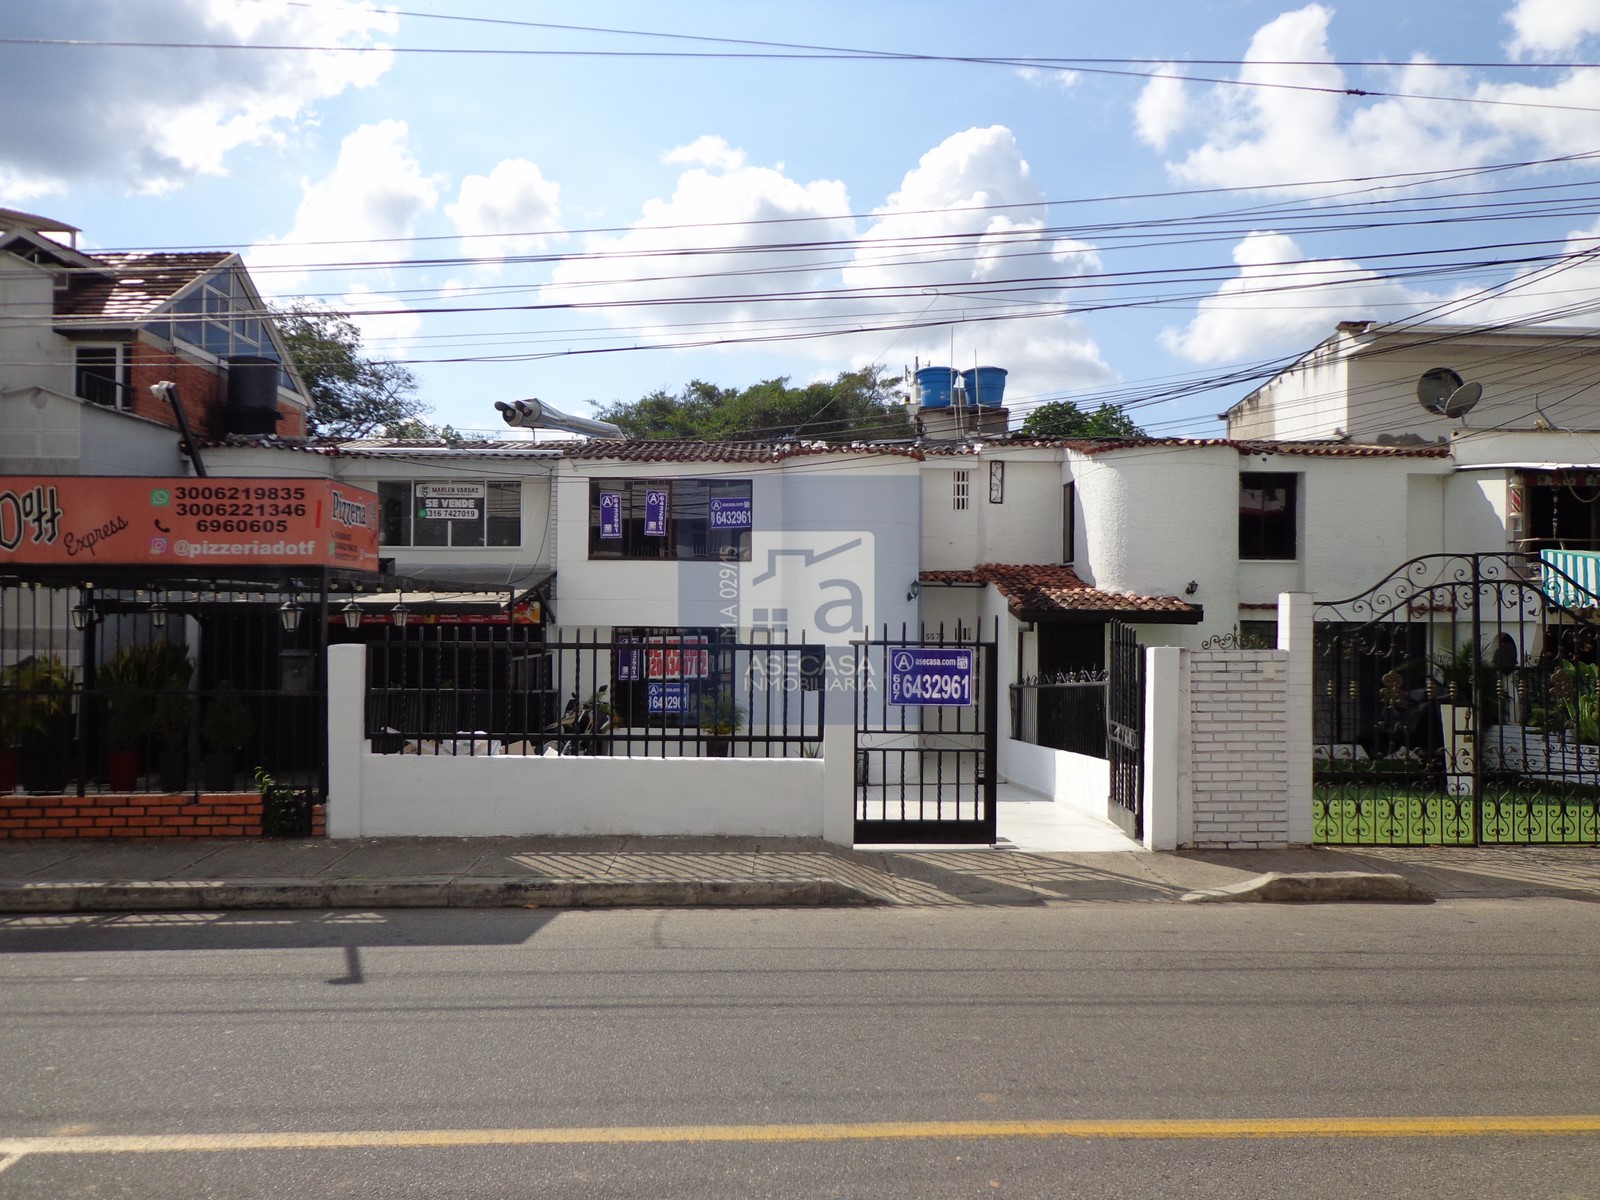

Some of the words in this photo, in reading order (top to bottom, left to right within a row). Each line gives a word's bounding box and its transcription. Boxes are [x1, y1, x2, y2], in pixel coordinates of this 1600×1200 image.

[175, 487, 305, 500] 3006219835
[176, 503, 306, 516] 3006221346
[332, 489, 367, 528] Pizzeria
[426, 499, 438, 508] SE
[441, 499, 474, 508] VENDE
[716, 511, 750, 524] 6432961
[196, 520, 288, 532] 6960605
[64, 516, 128, 556] Express
[902, 674, 969, 699] 6432961
